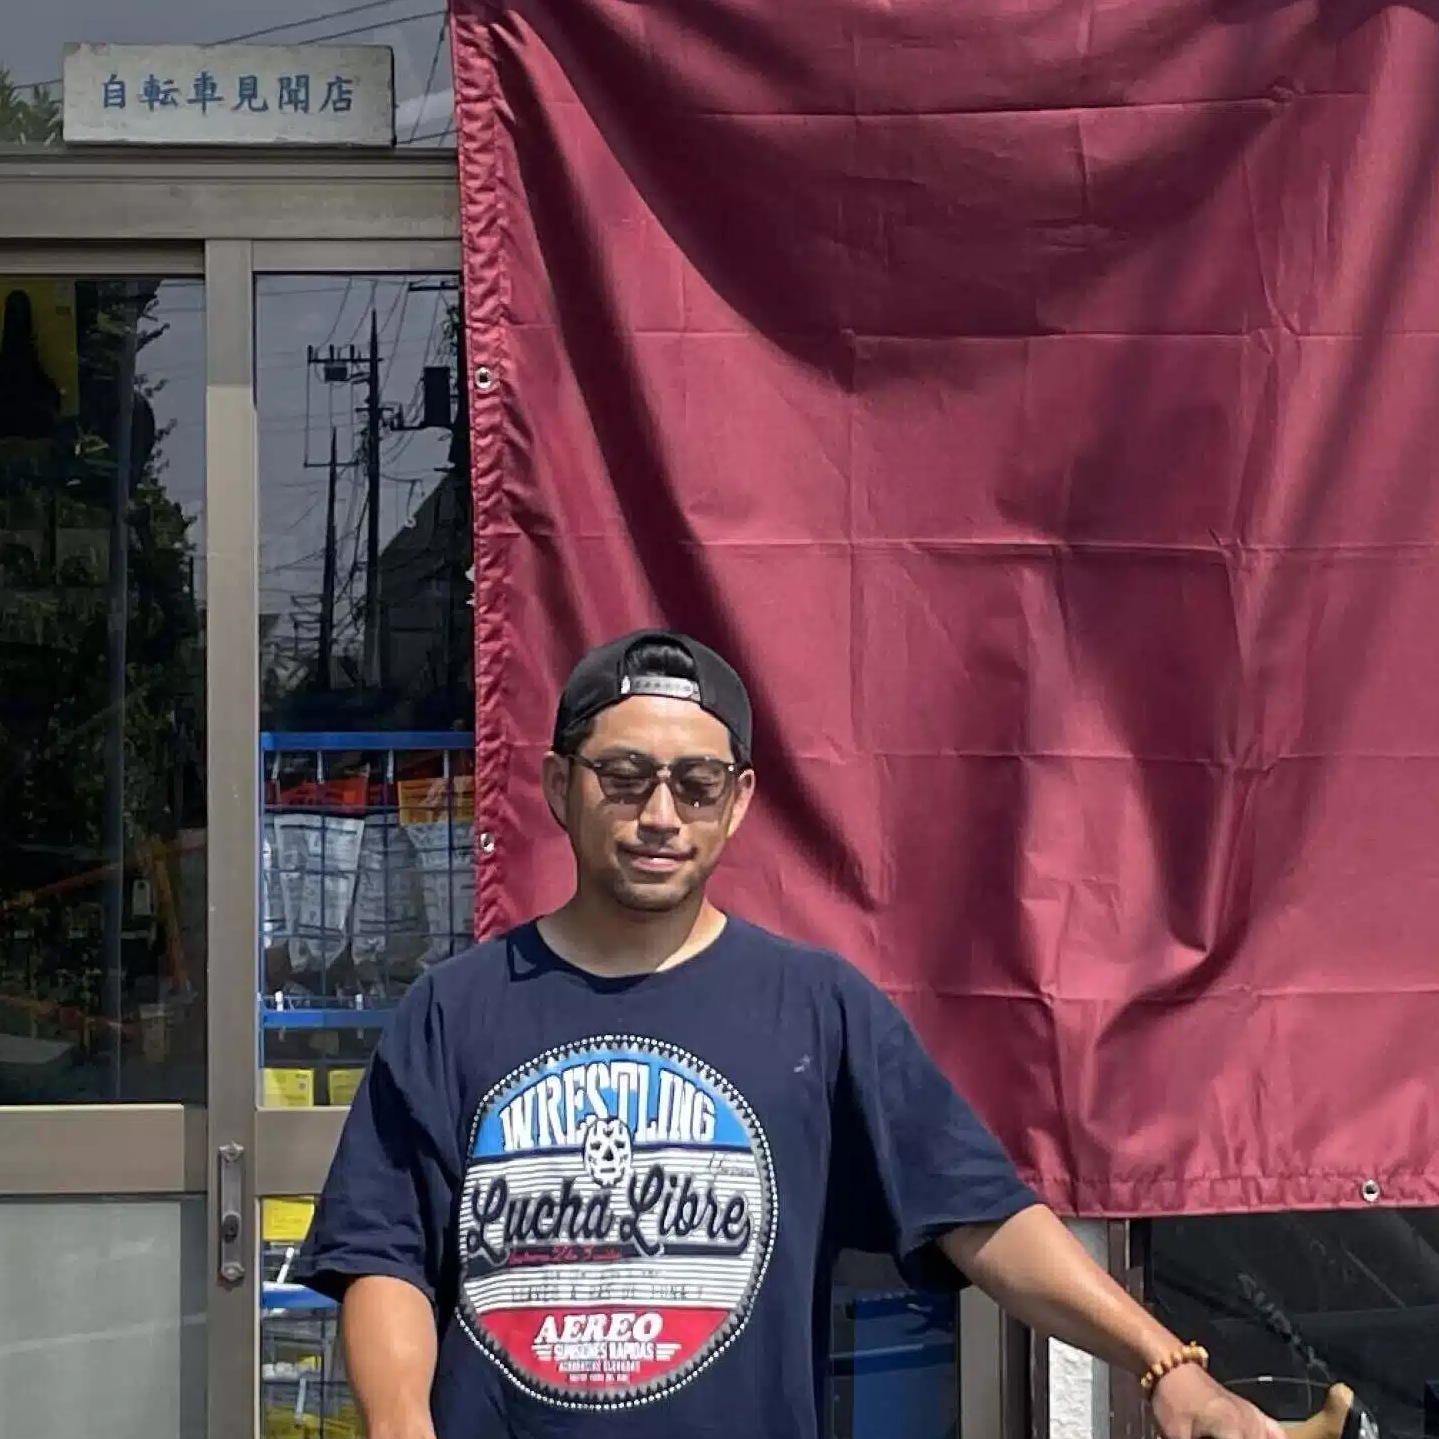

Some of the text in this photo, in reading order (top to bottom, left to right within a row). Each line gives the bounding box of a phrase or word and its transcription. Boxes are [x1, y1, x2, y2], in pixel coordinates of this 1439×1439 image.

[101, 71, 355, 115] 自転車見聞店
[499, 1060, 716, 1151] WRESTLING
[467, 1165, 752, 1262] Lucha Libre
[533, 1313, 663, 1344] AEREO
